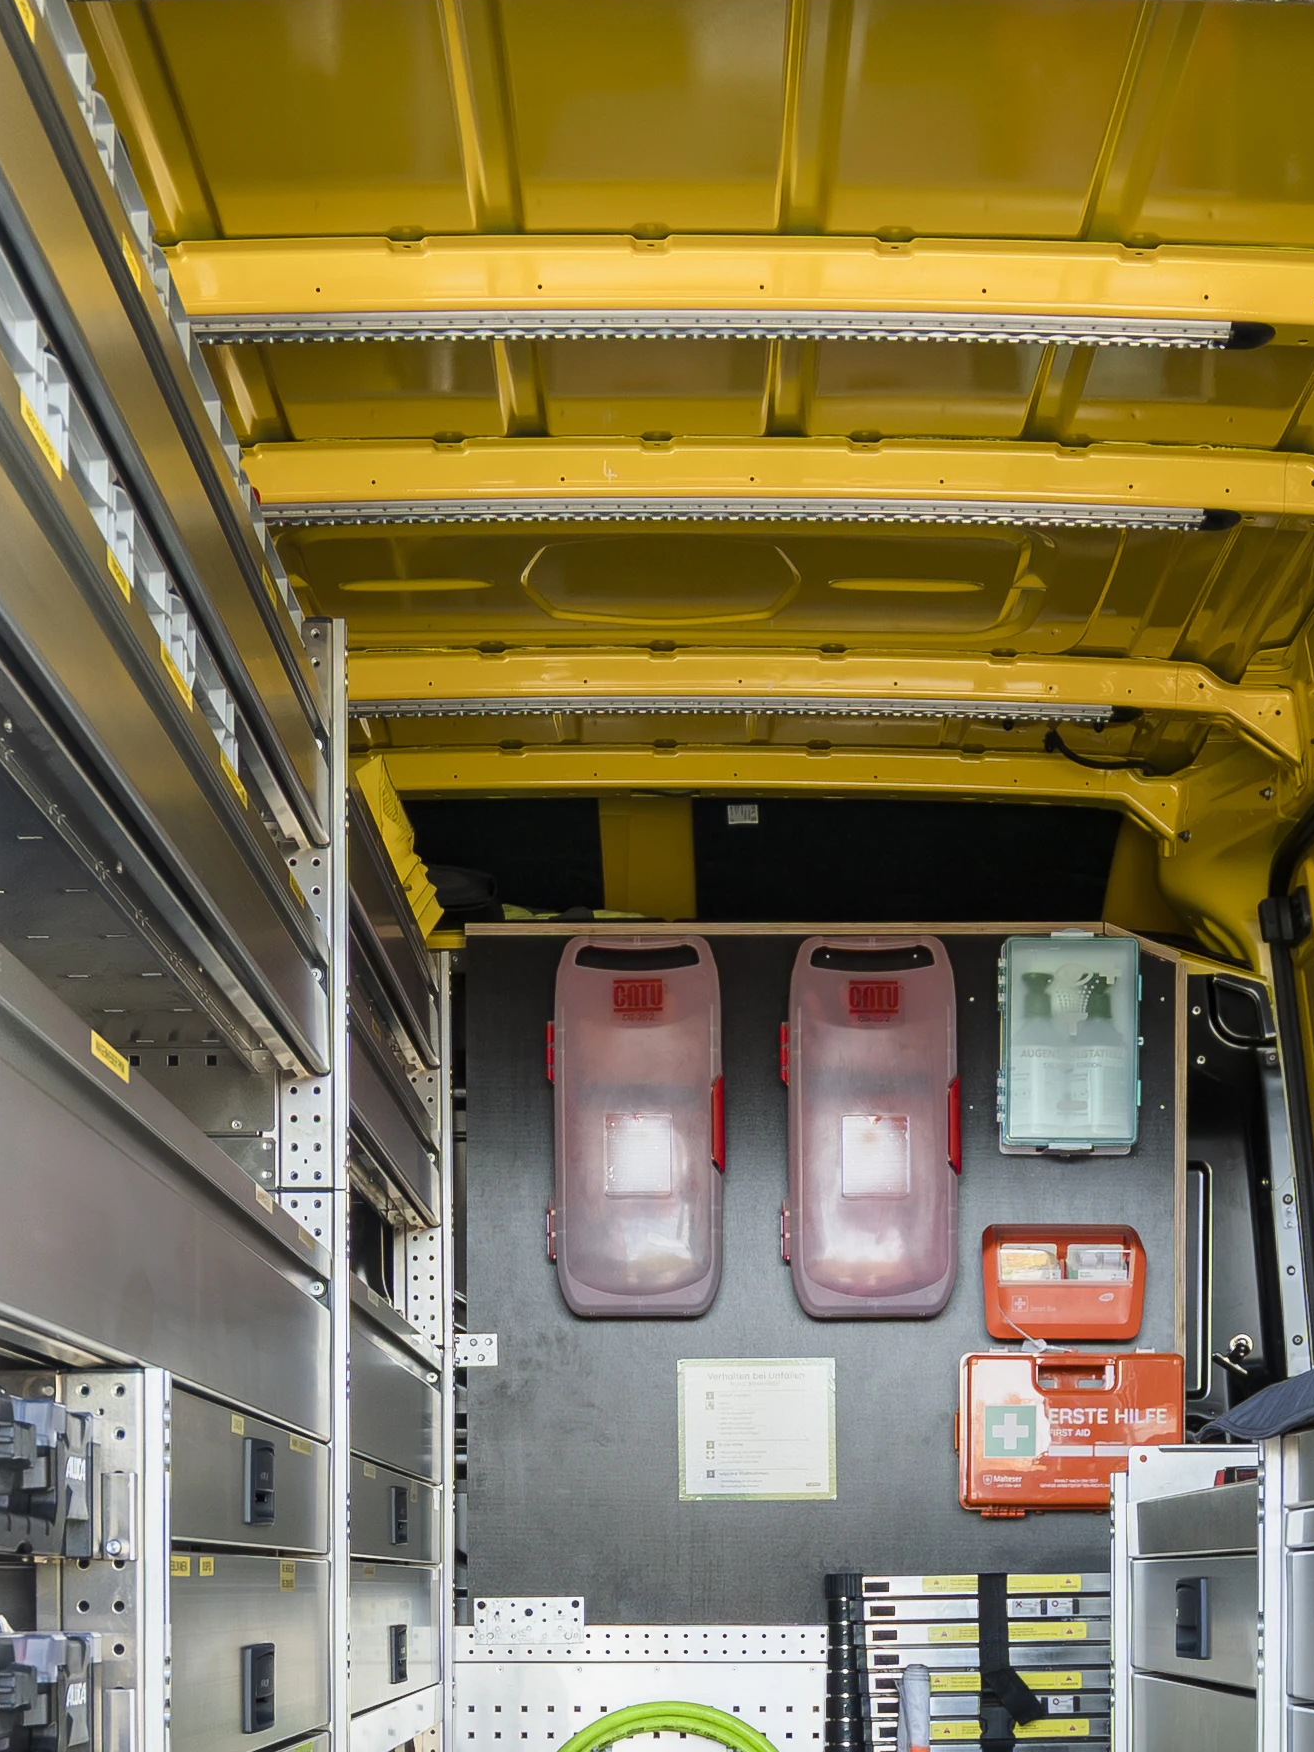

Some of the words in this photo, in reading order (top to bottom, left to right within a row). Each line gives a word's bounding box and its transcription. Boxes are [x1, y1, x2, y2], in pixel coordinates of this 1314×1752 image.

[613, 983, 663, 1008] CATU
[849, 984, 899, 1009] CATU
[707, 1371, 750, 1381] Verhalten
[752, 1371, 767, 1380] bei
[1047, 1408, 1109, 1425] ERSTE
[1115, 1408, 1168, 1425] HILFE
[1074, 1428, 1091, 1438] AID
